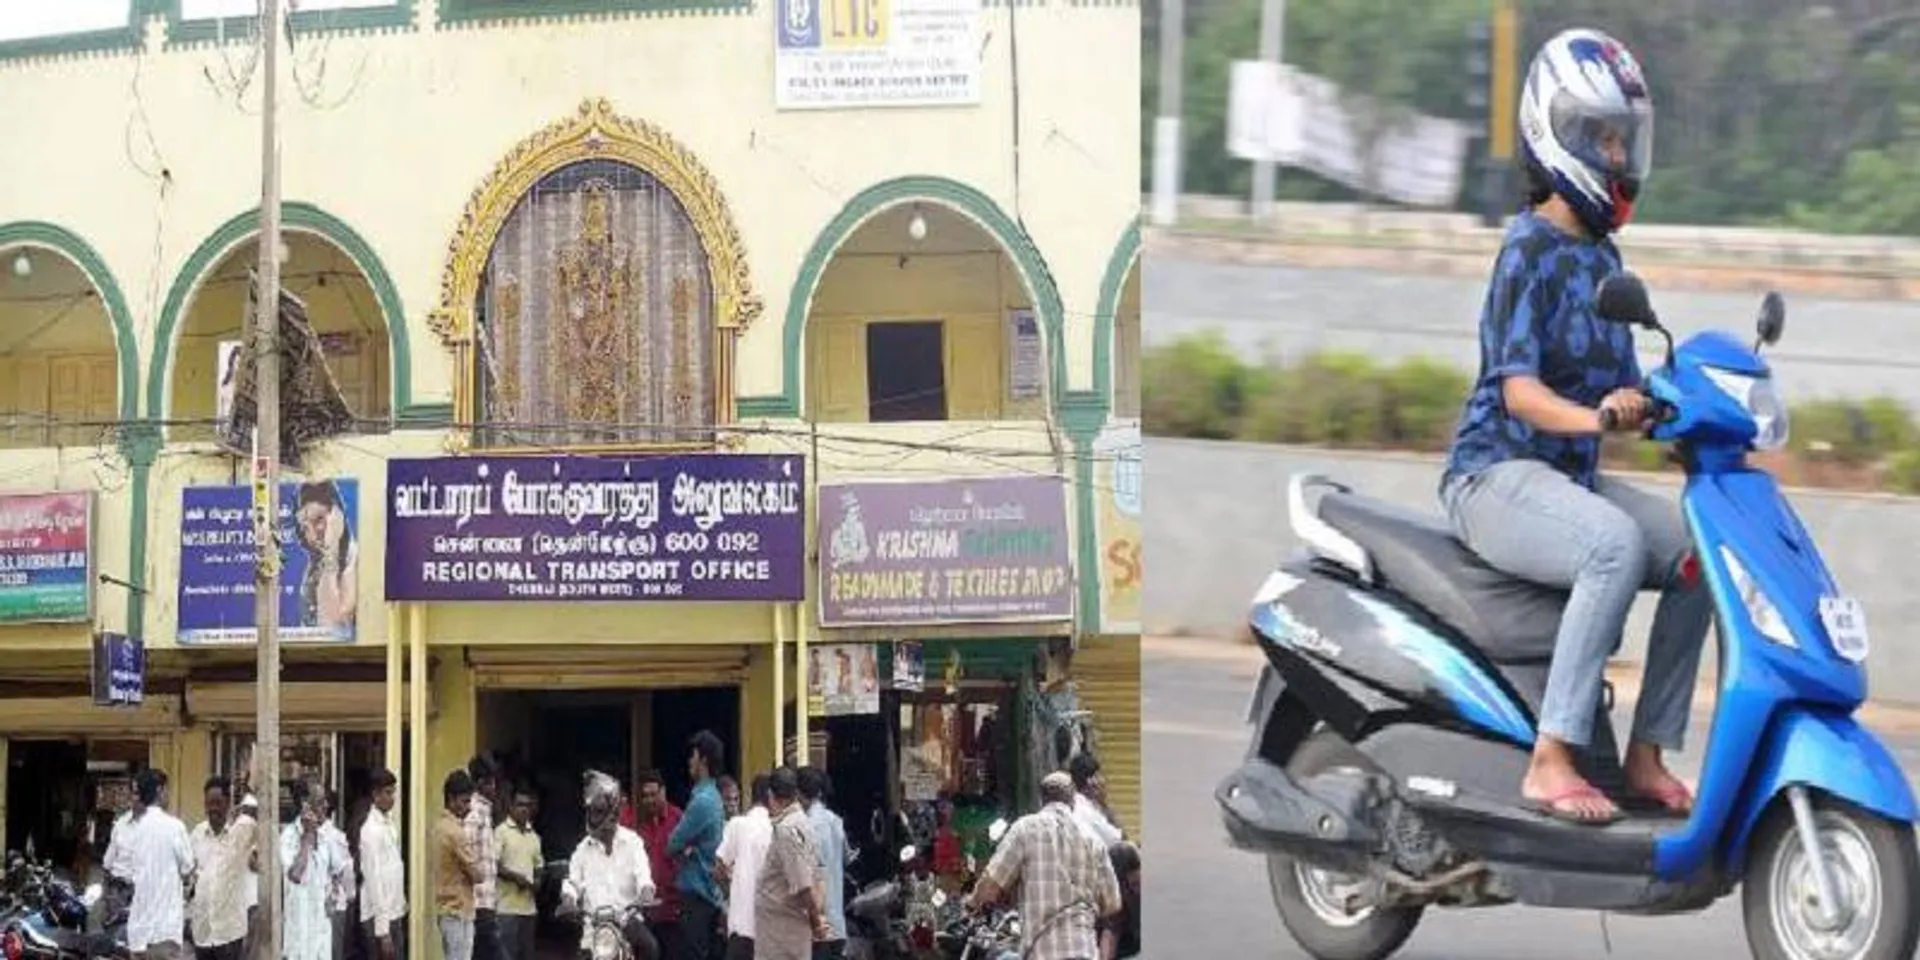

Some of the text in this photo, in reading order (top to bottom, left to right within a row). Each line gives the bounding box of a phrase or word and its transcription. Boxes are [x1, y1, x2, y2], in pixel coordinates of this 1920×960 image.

[665, 532, 709, 551] 600
[717, 532, 760, 551] 092
[876, 529, 960, 559] KRISHNA
[422, 560, 770, 581] REGIONAL TRANSPORT OFFICE
